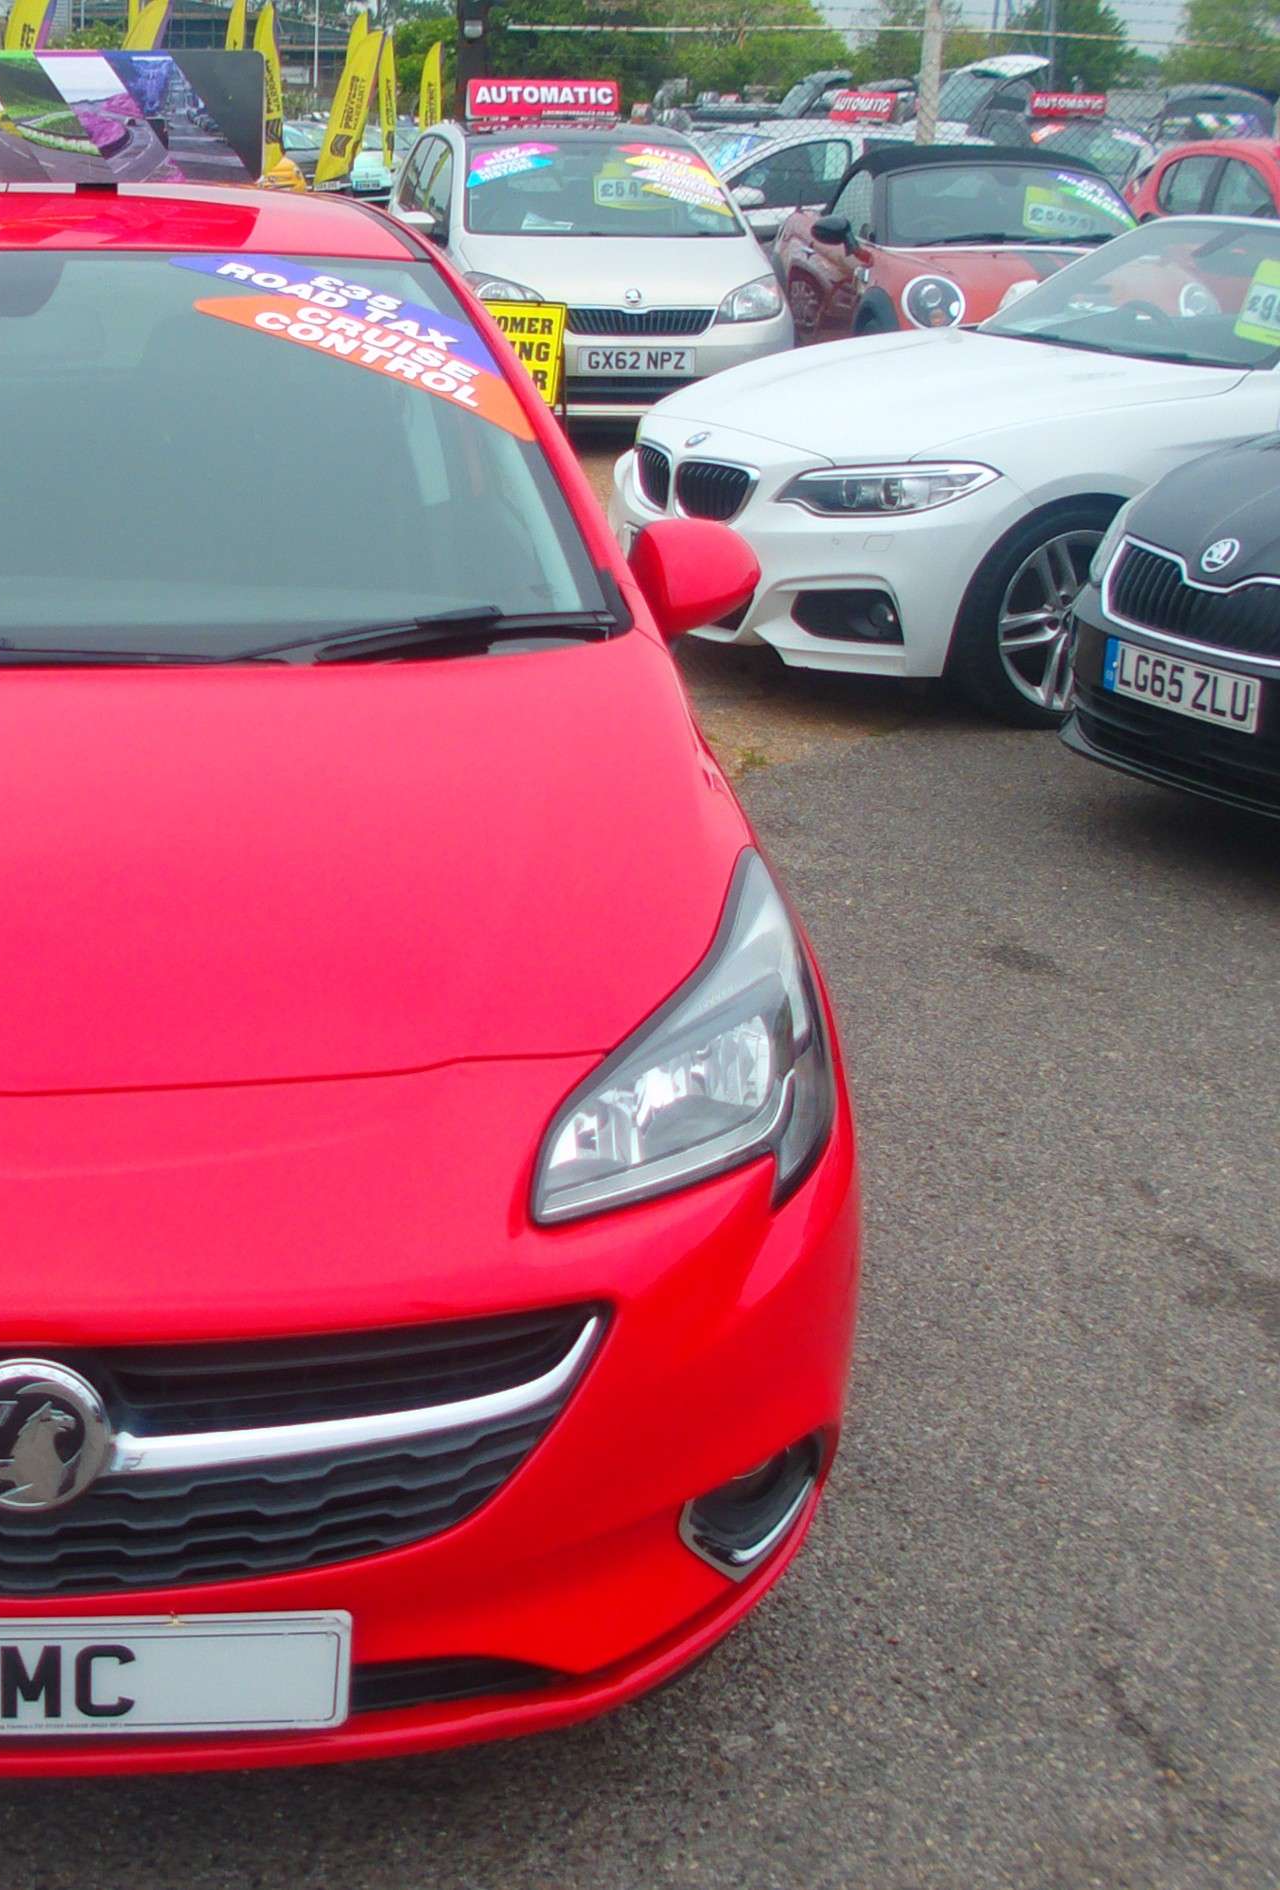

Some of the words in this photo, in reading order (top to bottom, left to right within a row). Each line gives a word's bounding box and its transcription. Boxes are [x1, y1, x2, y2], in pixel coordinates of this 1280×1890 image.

[475, 86, 613, 105] AUTOMATIC
[833, 97, 891, 113] AUTOMATIC
[1033, 95, 1106, 110] AUTOMATIC
[641, 147, 692, 163] AUTO
[310, 275, 402, 312] £35
[216, 262, 349, 309] ROAD
[365, 305, 459, 350] TAX
[494, 317, 554, 335] OMER
[296, 306, 480, 383] CRUISE
[254, 311, 480, 408] CONTROL
[588, 351, 641, 370] GX62
[646, 351, 685, 370] NPZ
[1118, 648, 1185, 703] LG65
[1191, 672, 1251, 722] ZLU
